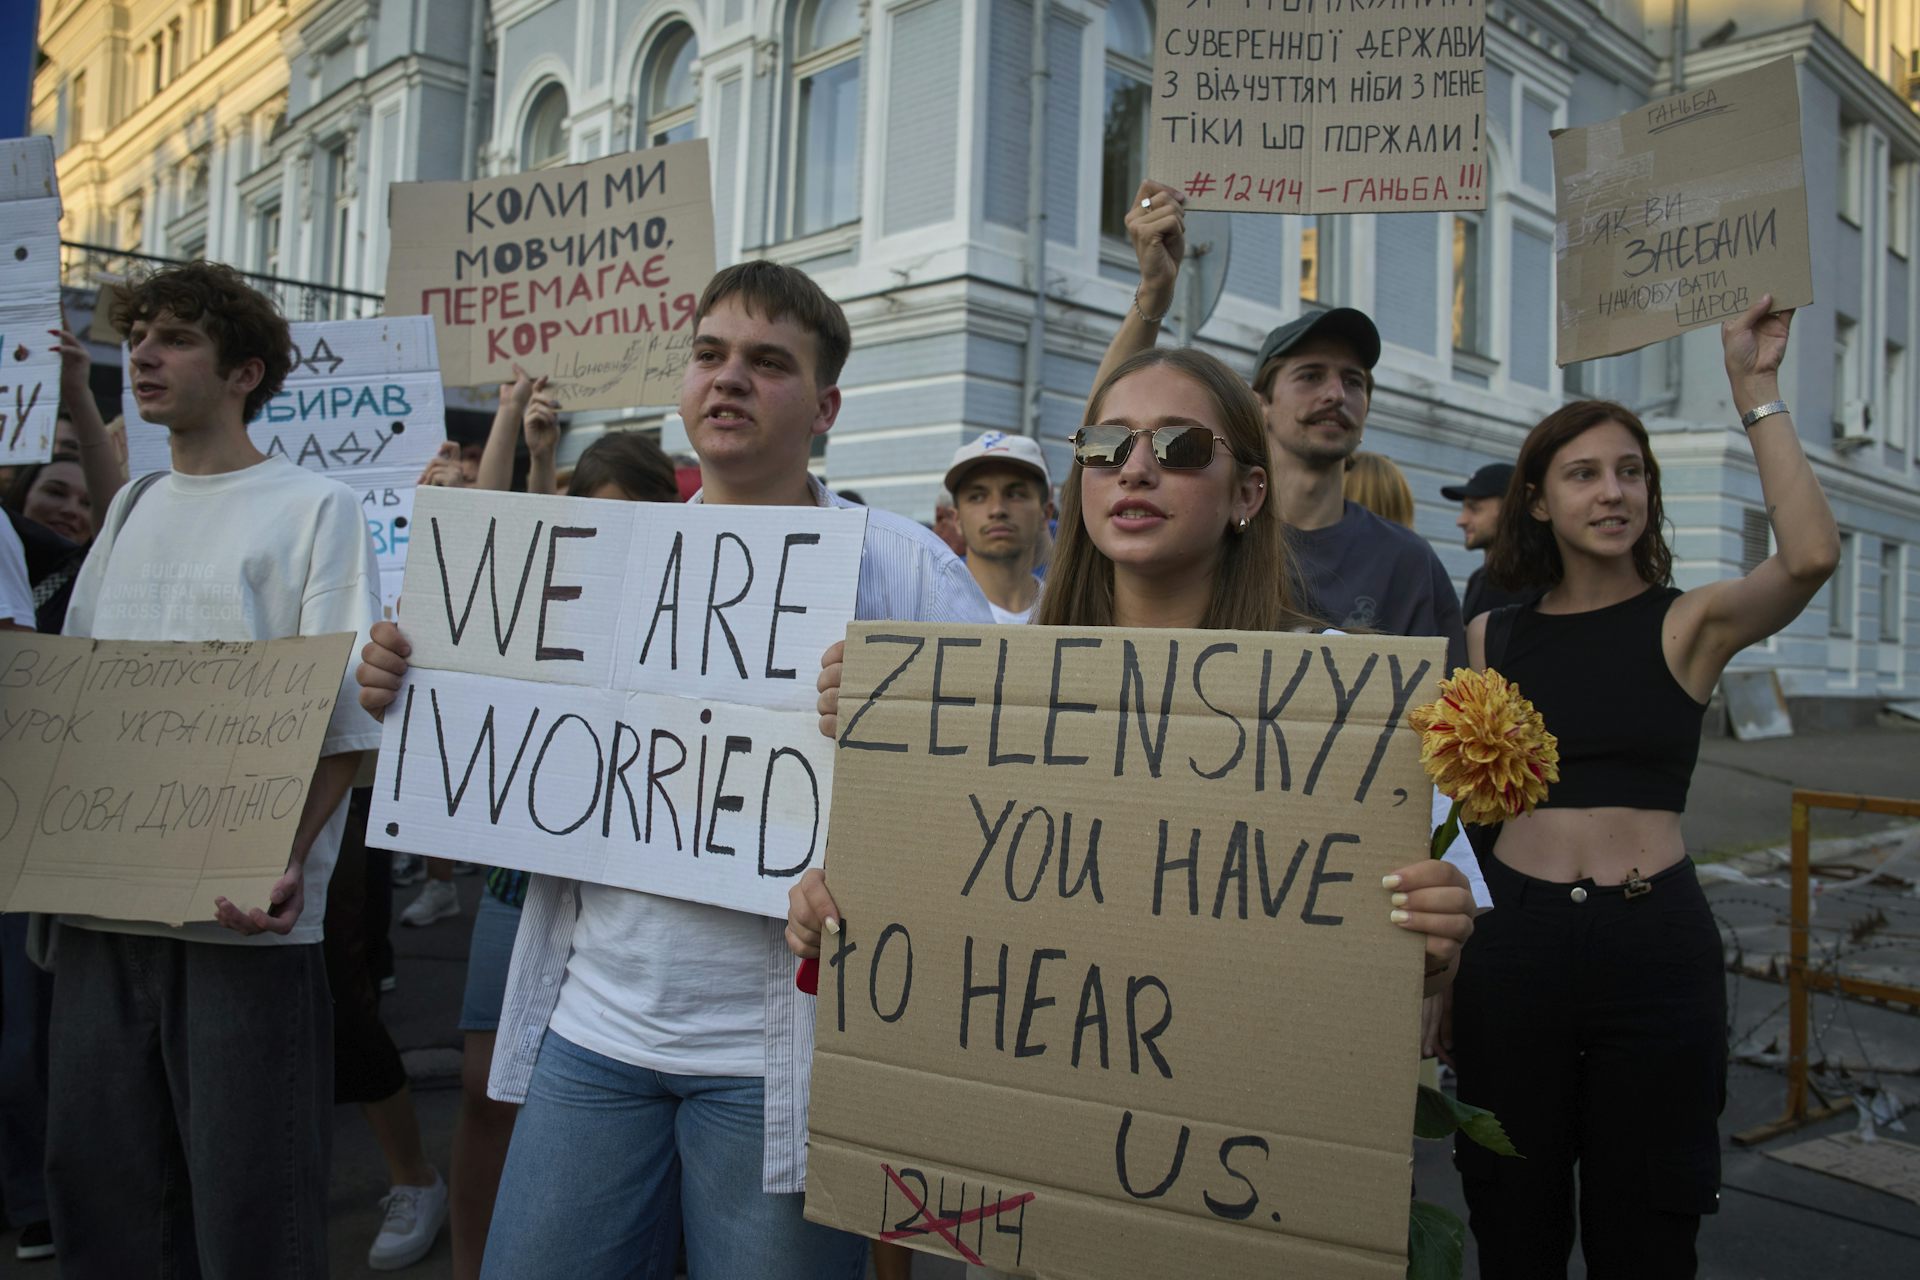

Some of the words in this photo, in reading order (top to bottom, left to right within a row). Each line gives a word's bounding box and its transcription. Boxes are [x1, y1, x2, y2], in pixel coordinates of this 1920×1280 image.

[1165, 28, 1343, 62] СУВЕРЕННОЇ
[1355, 26, 1485, 59] ДЕРЖАВИ
[1196, 67, 1336, 104] ВІДЧУТТЯМ
[1351, 70, 1402, 103] НІБИ
[1433, 69, 1484, 99] МЕНЕ
[1647, 88, 1717, 125] ГАНЬБА
[1161, 112, 1242, 147] ТІКИ
[1262, 122, 1305, 150] ШО
[466, 180, 588, 234] КОЛИ
[604, 160, 666, 209] МИ
[1592, 205, 1631, 246] ЯК
[1644, 193, 1683, 228] ВИ
[454, 216, 674, 281] МОВЧИМО,
[421, 254, 671, 326] ПЕРЕМАГАЄ
[1675, 286, 1749, 323] НАРОД
[141, 563, 217, 579] BUILDING
[431, 516, 597, 662] WE
[639, 531, 821, 680] ARE
[0, 649, 82, 694] ВИ
[87, 657, 317, 698] ПРОПУСТИЛИ
[0, 707, 95, 744] УРОК
[838, 633, 1431, 806] ZELENSKYY,
[41, 784, 135, 836] СОВА
[960, 794, 1104, 904] YOU
[1152, 819, 1361, 926] HAVE
[959, 935, 1173, 1079] HEAR
